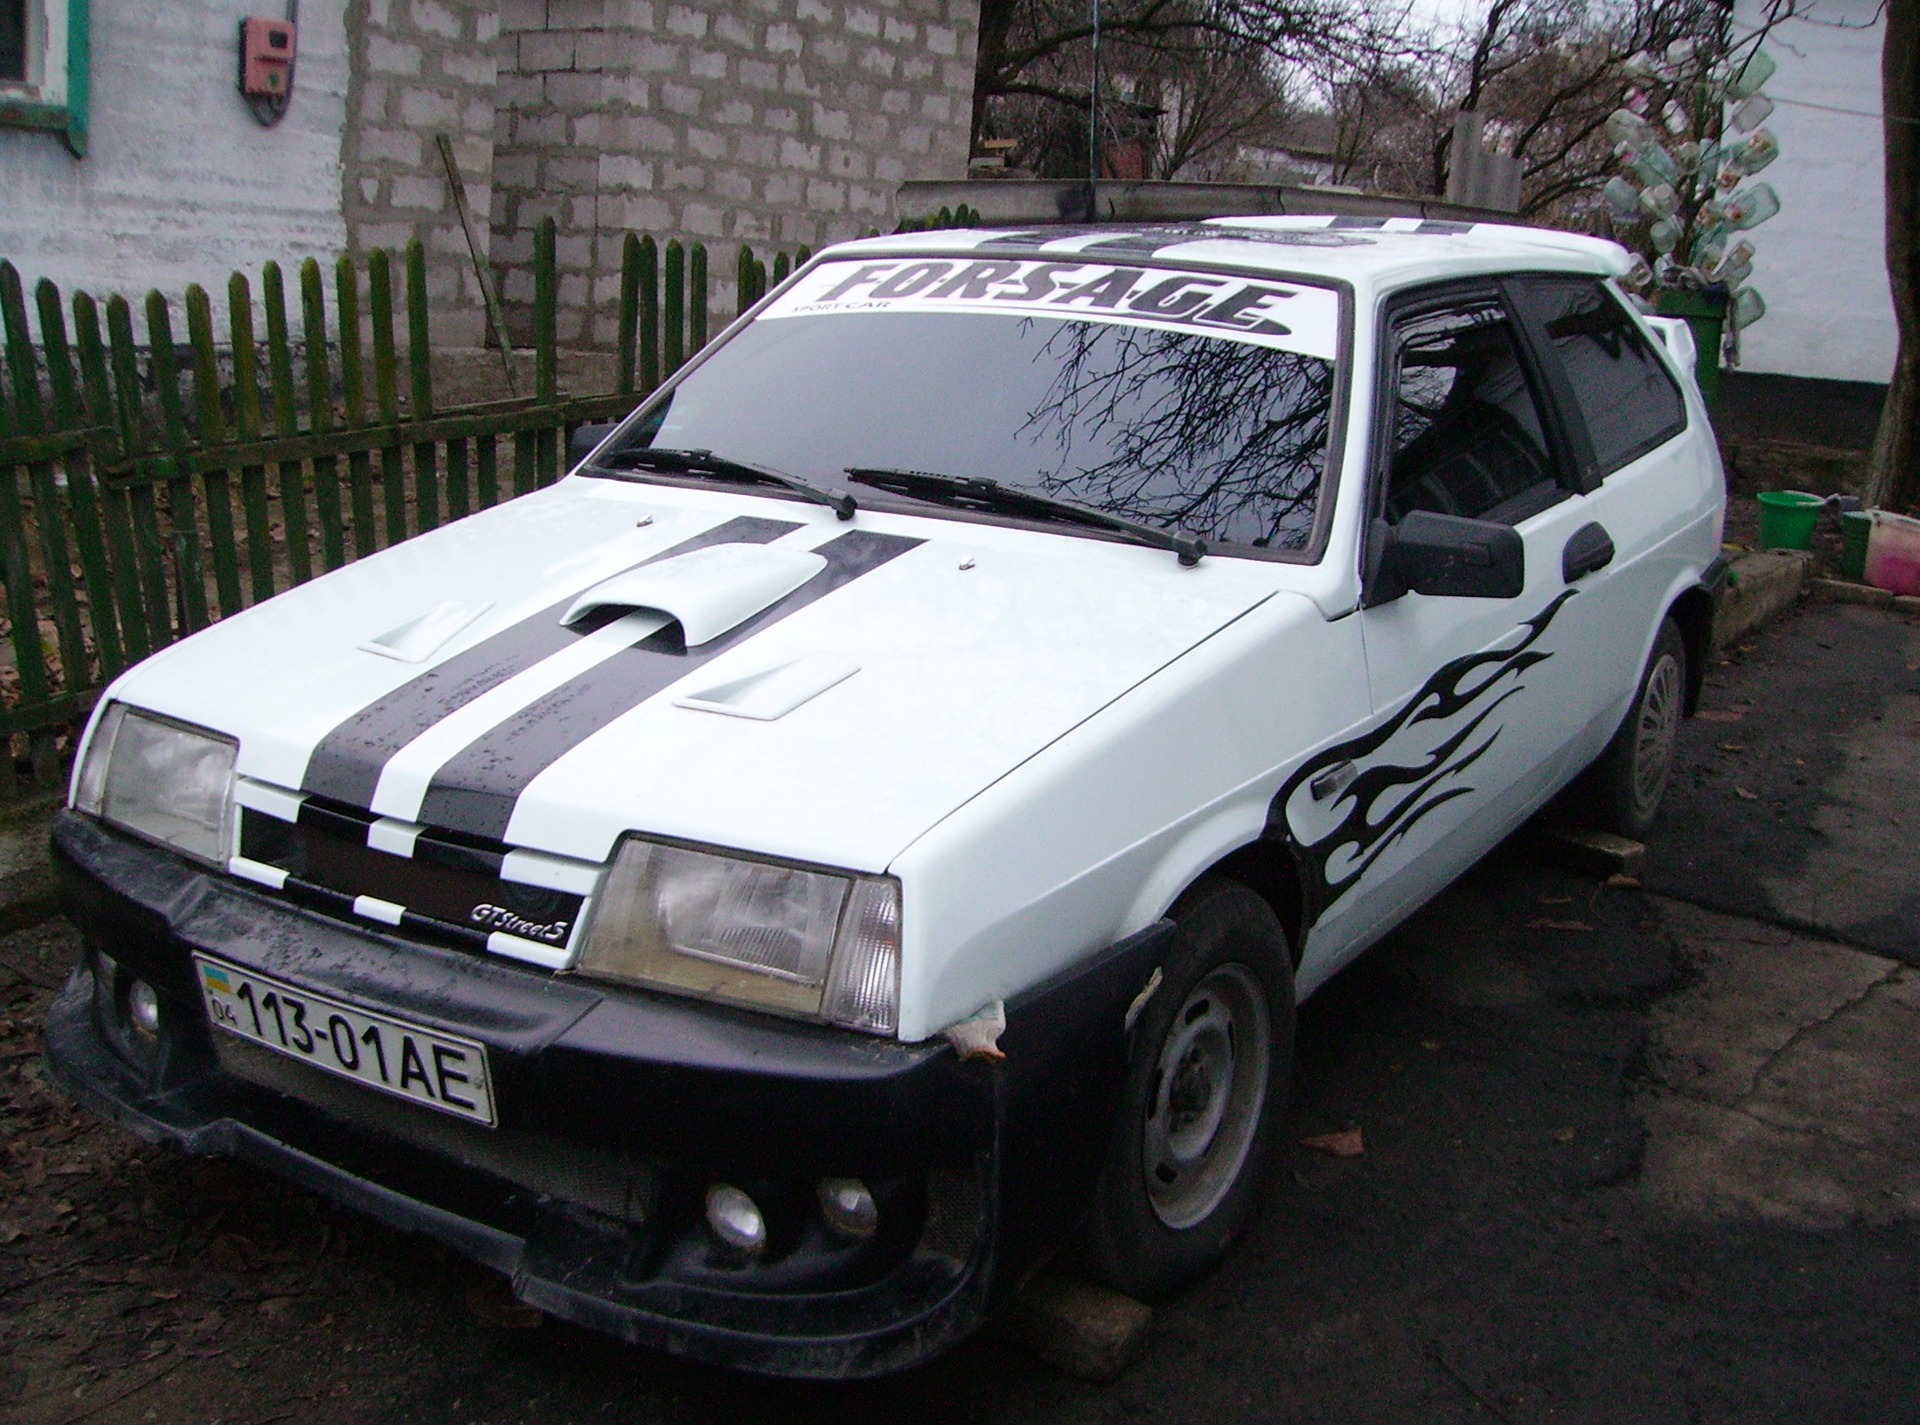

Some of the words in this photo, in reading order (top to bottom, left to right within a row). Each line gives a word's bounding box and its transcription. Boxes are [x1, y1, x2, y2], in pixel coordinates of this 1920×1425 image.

[792, 302, 842, 313] SPORT
[845, 301, 891, 310] CAR
[815, 260, 1298, 335] FORSAGE
[211, 997, 238, 1027] 04
